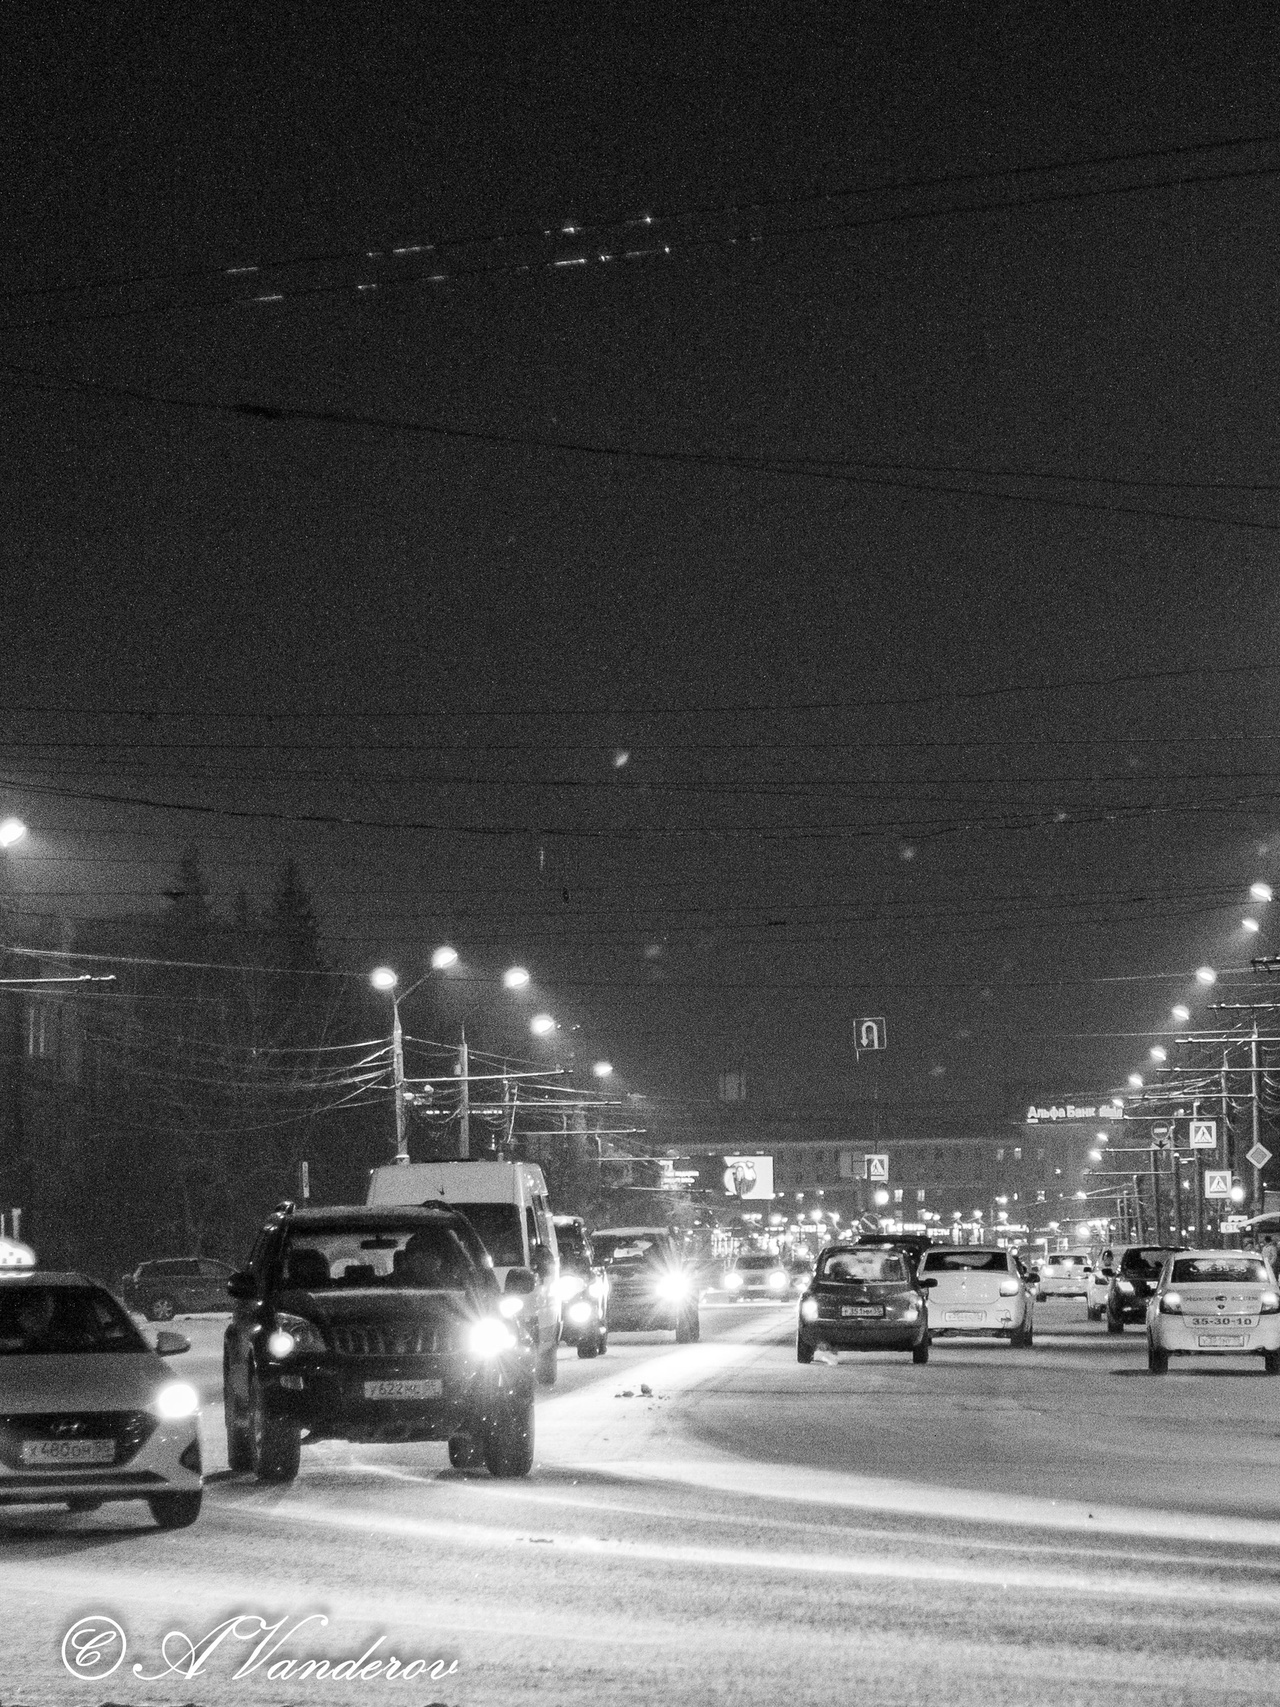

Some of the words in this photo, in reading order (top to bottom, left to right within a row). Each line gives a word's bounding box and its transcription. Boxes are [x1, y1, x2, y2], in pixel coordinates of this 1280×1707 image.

[1027, 1106, 1066, 1120] Альфа
[1066, 1105, 1096, 1118] Банк
[1192, 1318, 1252, 1326] 35-30-10
